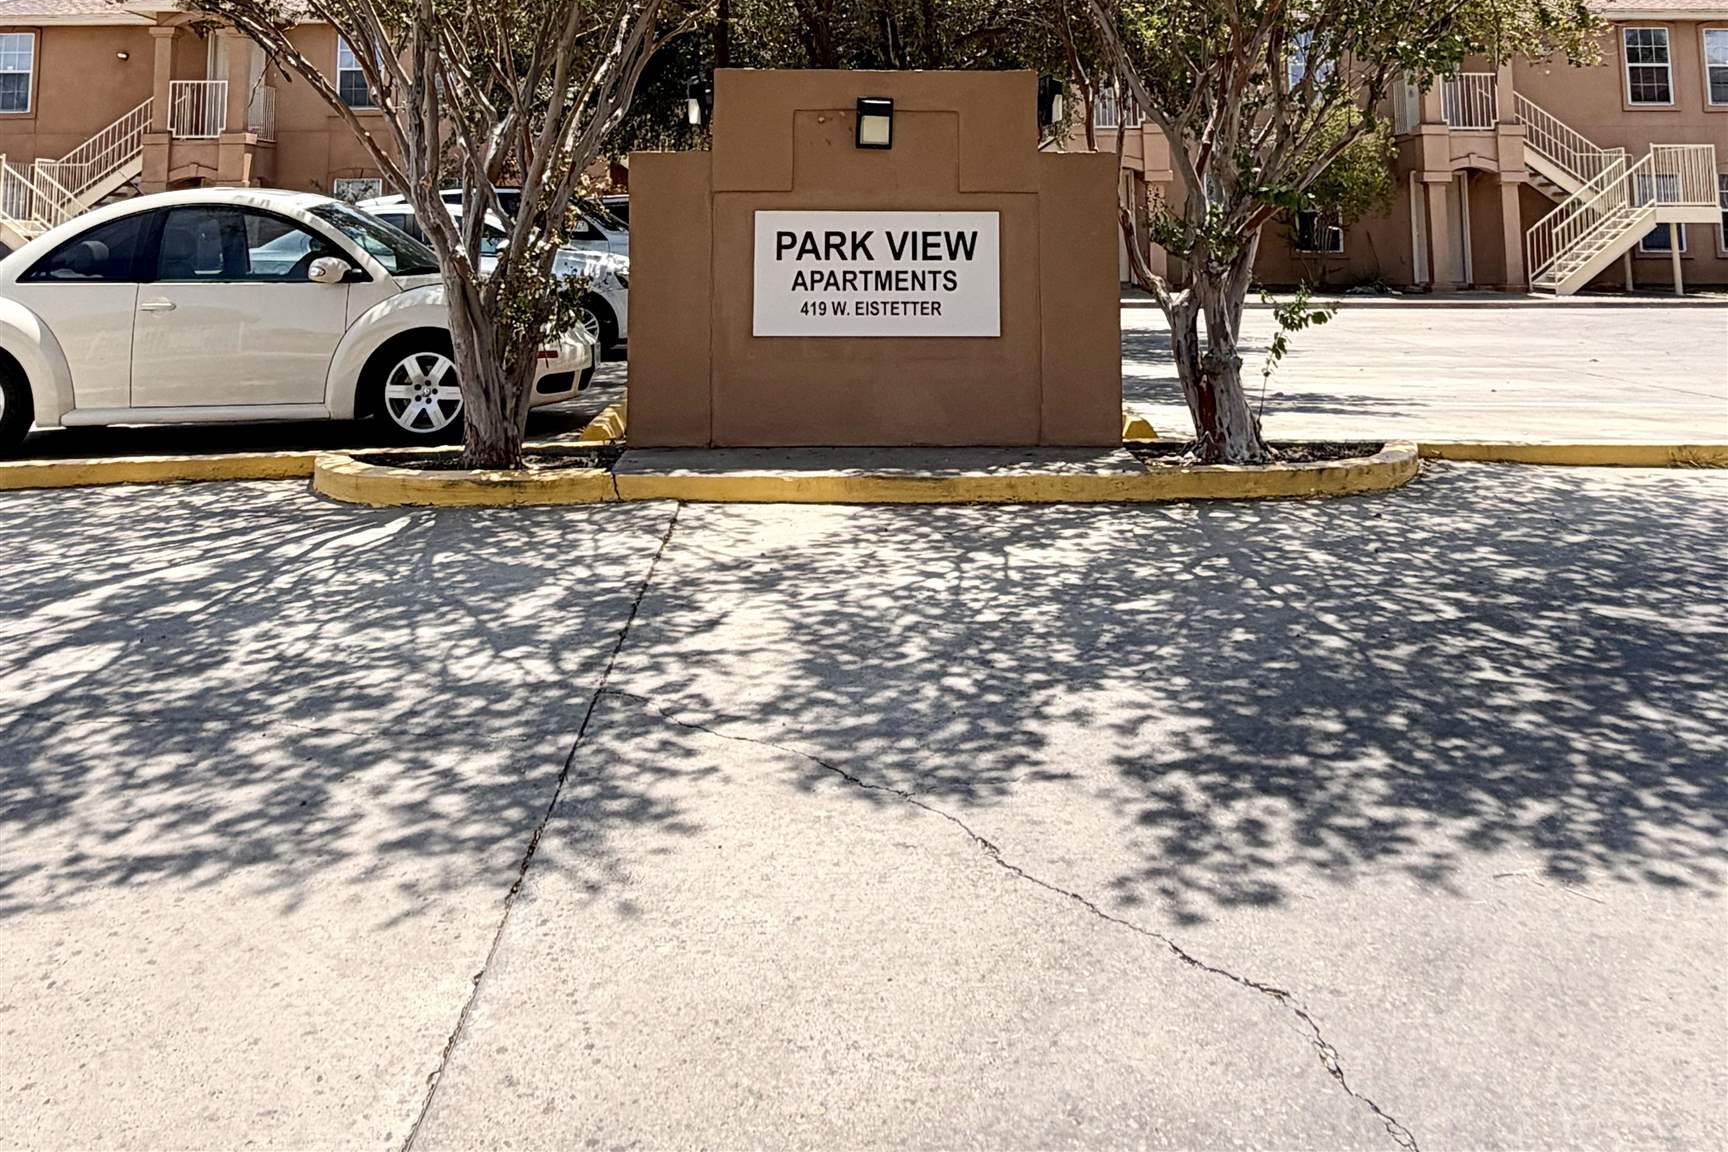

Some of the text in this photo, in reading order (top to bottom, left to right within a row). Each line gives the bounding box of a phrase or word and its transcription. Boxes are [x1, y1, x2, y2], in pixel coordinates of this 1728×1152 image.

[775, 230, 979, 261] PARK VIEW
[791, 269, 958, 292] APARTMENTS
[800, 300, 942, 316] 419 W. EISTETTER
